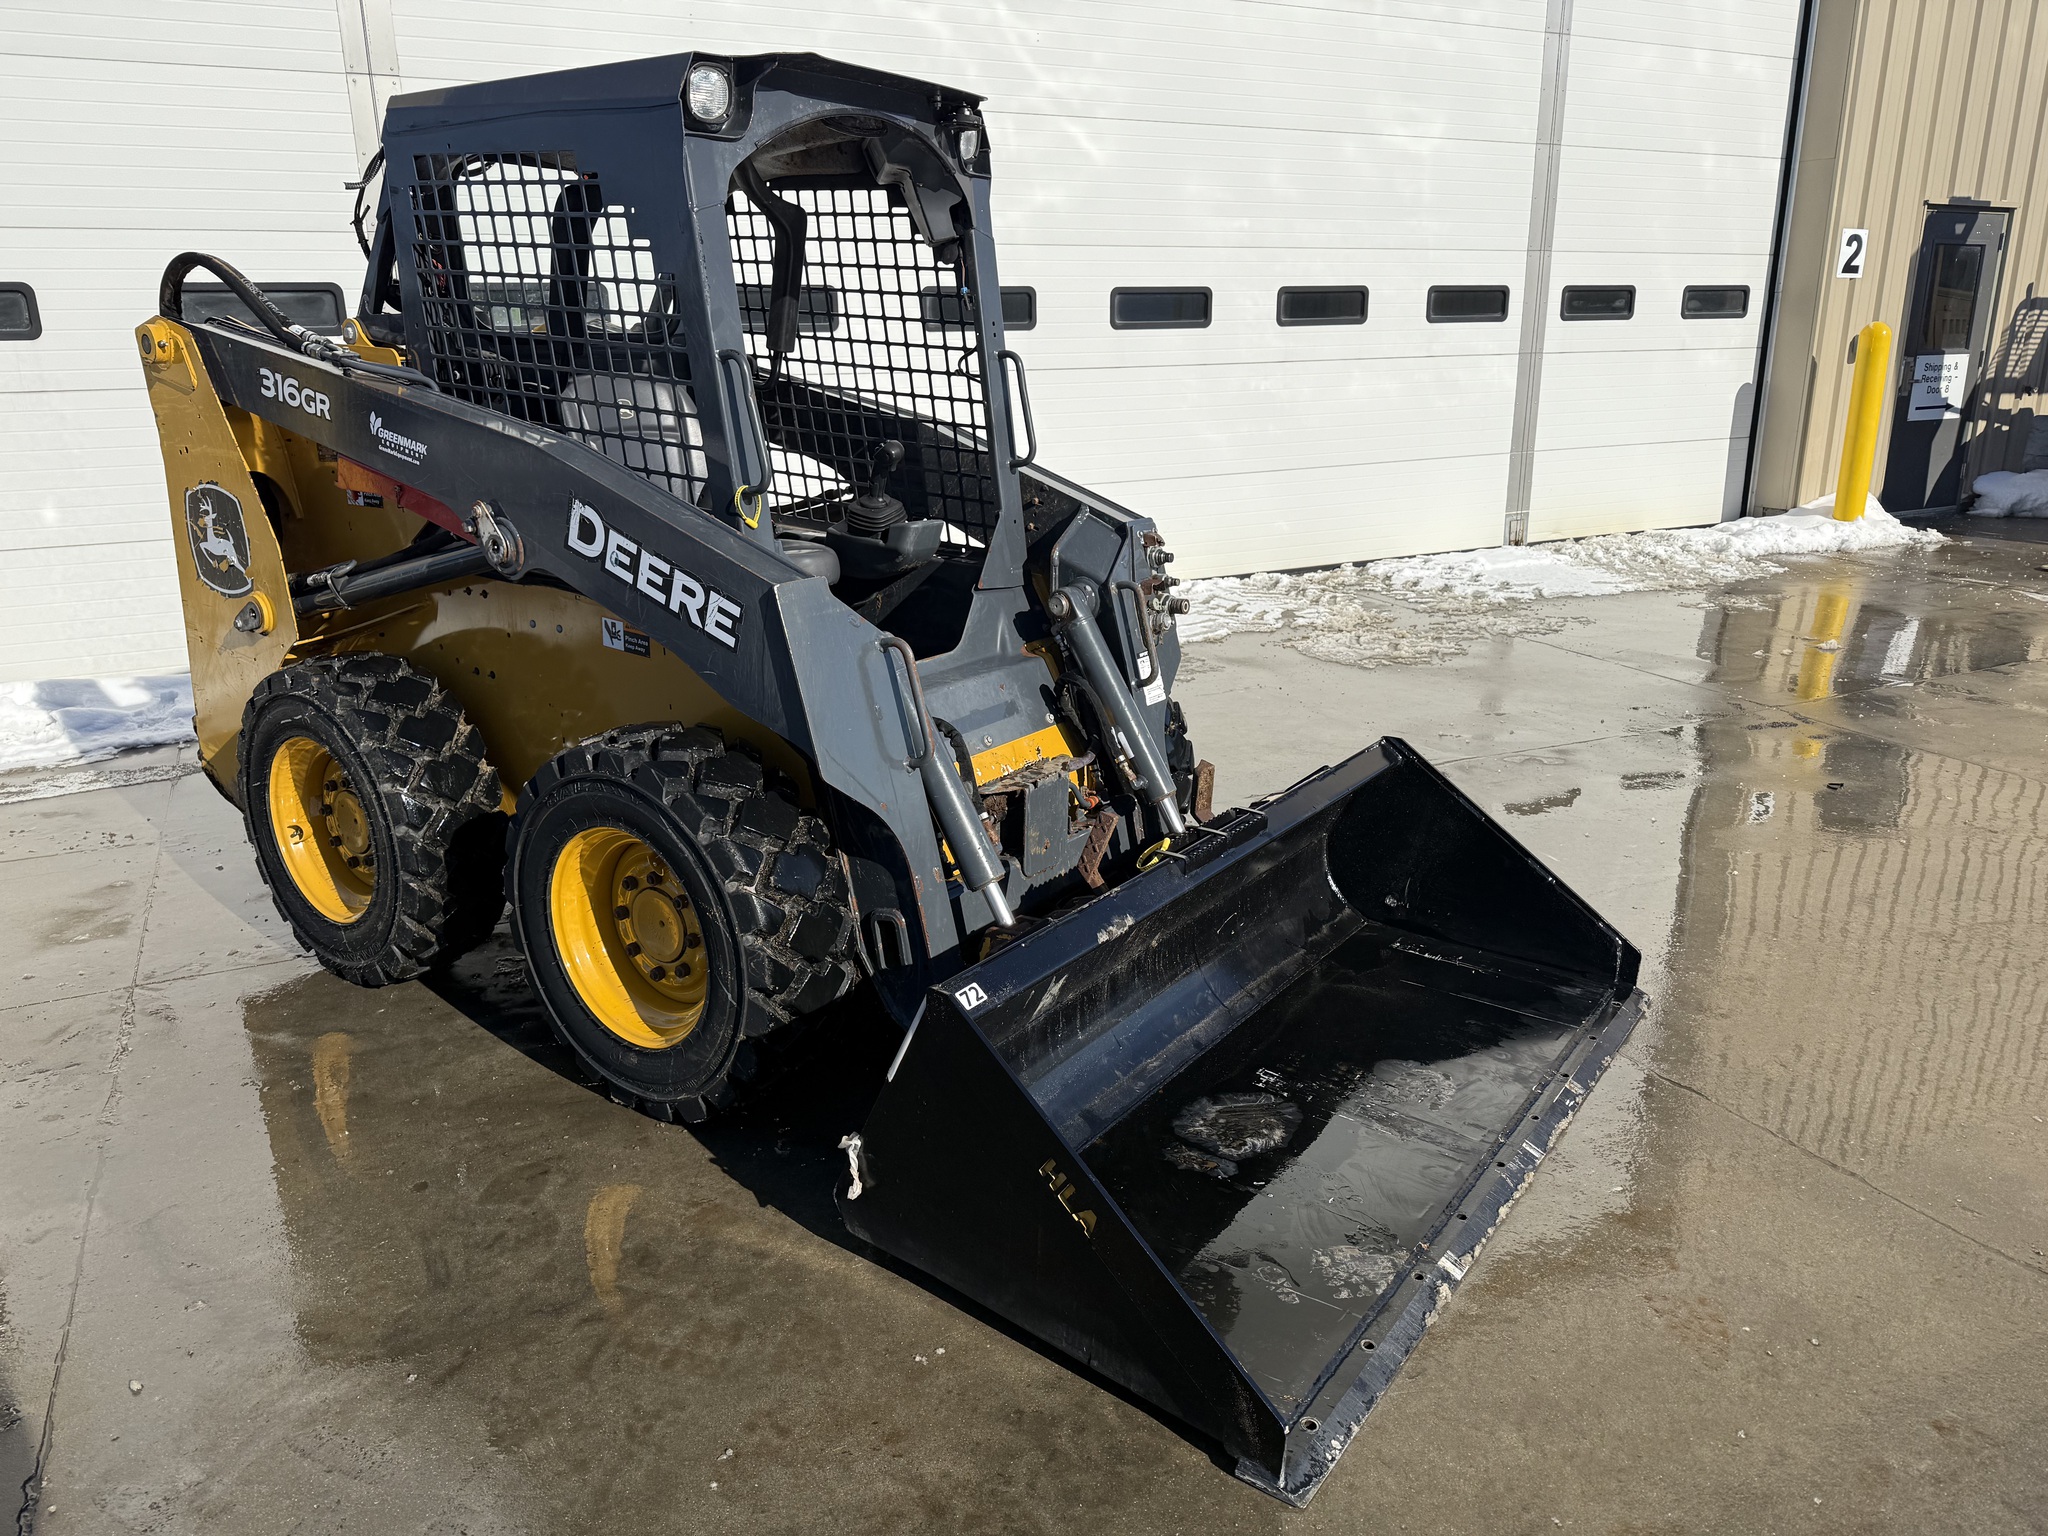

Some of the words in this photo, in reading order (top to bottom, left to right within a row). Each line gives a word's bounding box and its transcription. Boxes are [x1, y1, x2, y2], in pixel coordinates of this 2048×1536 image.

[1841, 233, 1863, 274] 2
[1921, 374, 1952, 384] Receiving
[1923, 362, 1952, 372] Shipping
[1953, 361, 1959, 370] &
[259, 367, 331, 420] 316GR
[1926, 385, 1943, 394] Door
[377, 427, 428, 456] GREENMARK
[567, 498, 741, 648] DEERE
[958, 986, 985, 1007] 72
[1038, 1158, 1098, 1239] HLA
